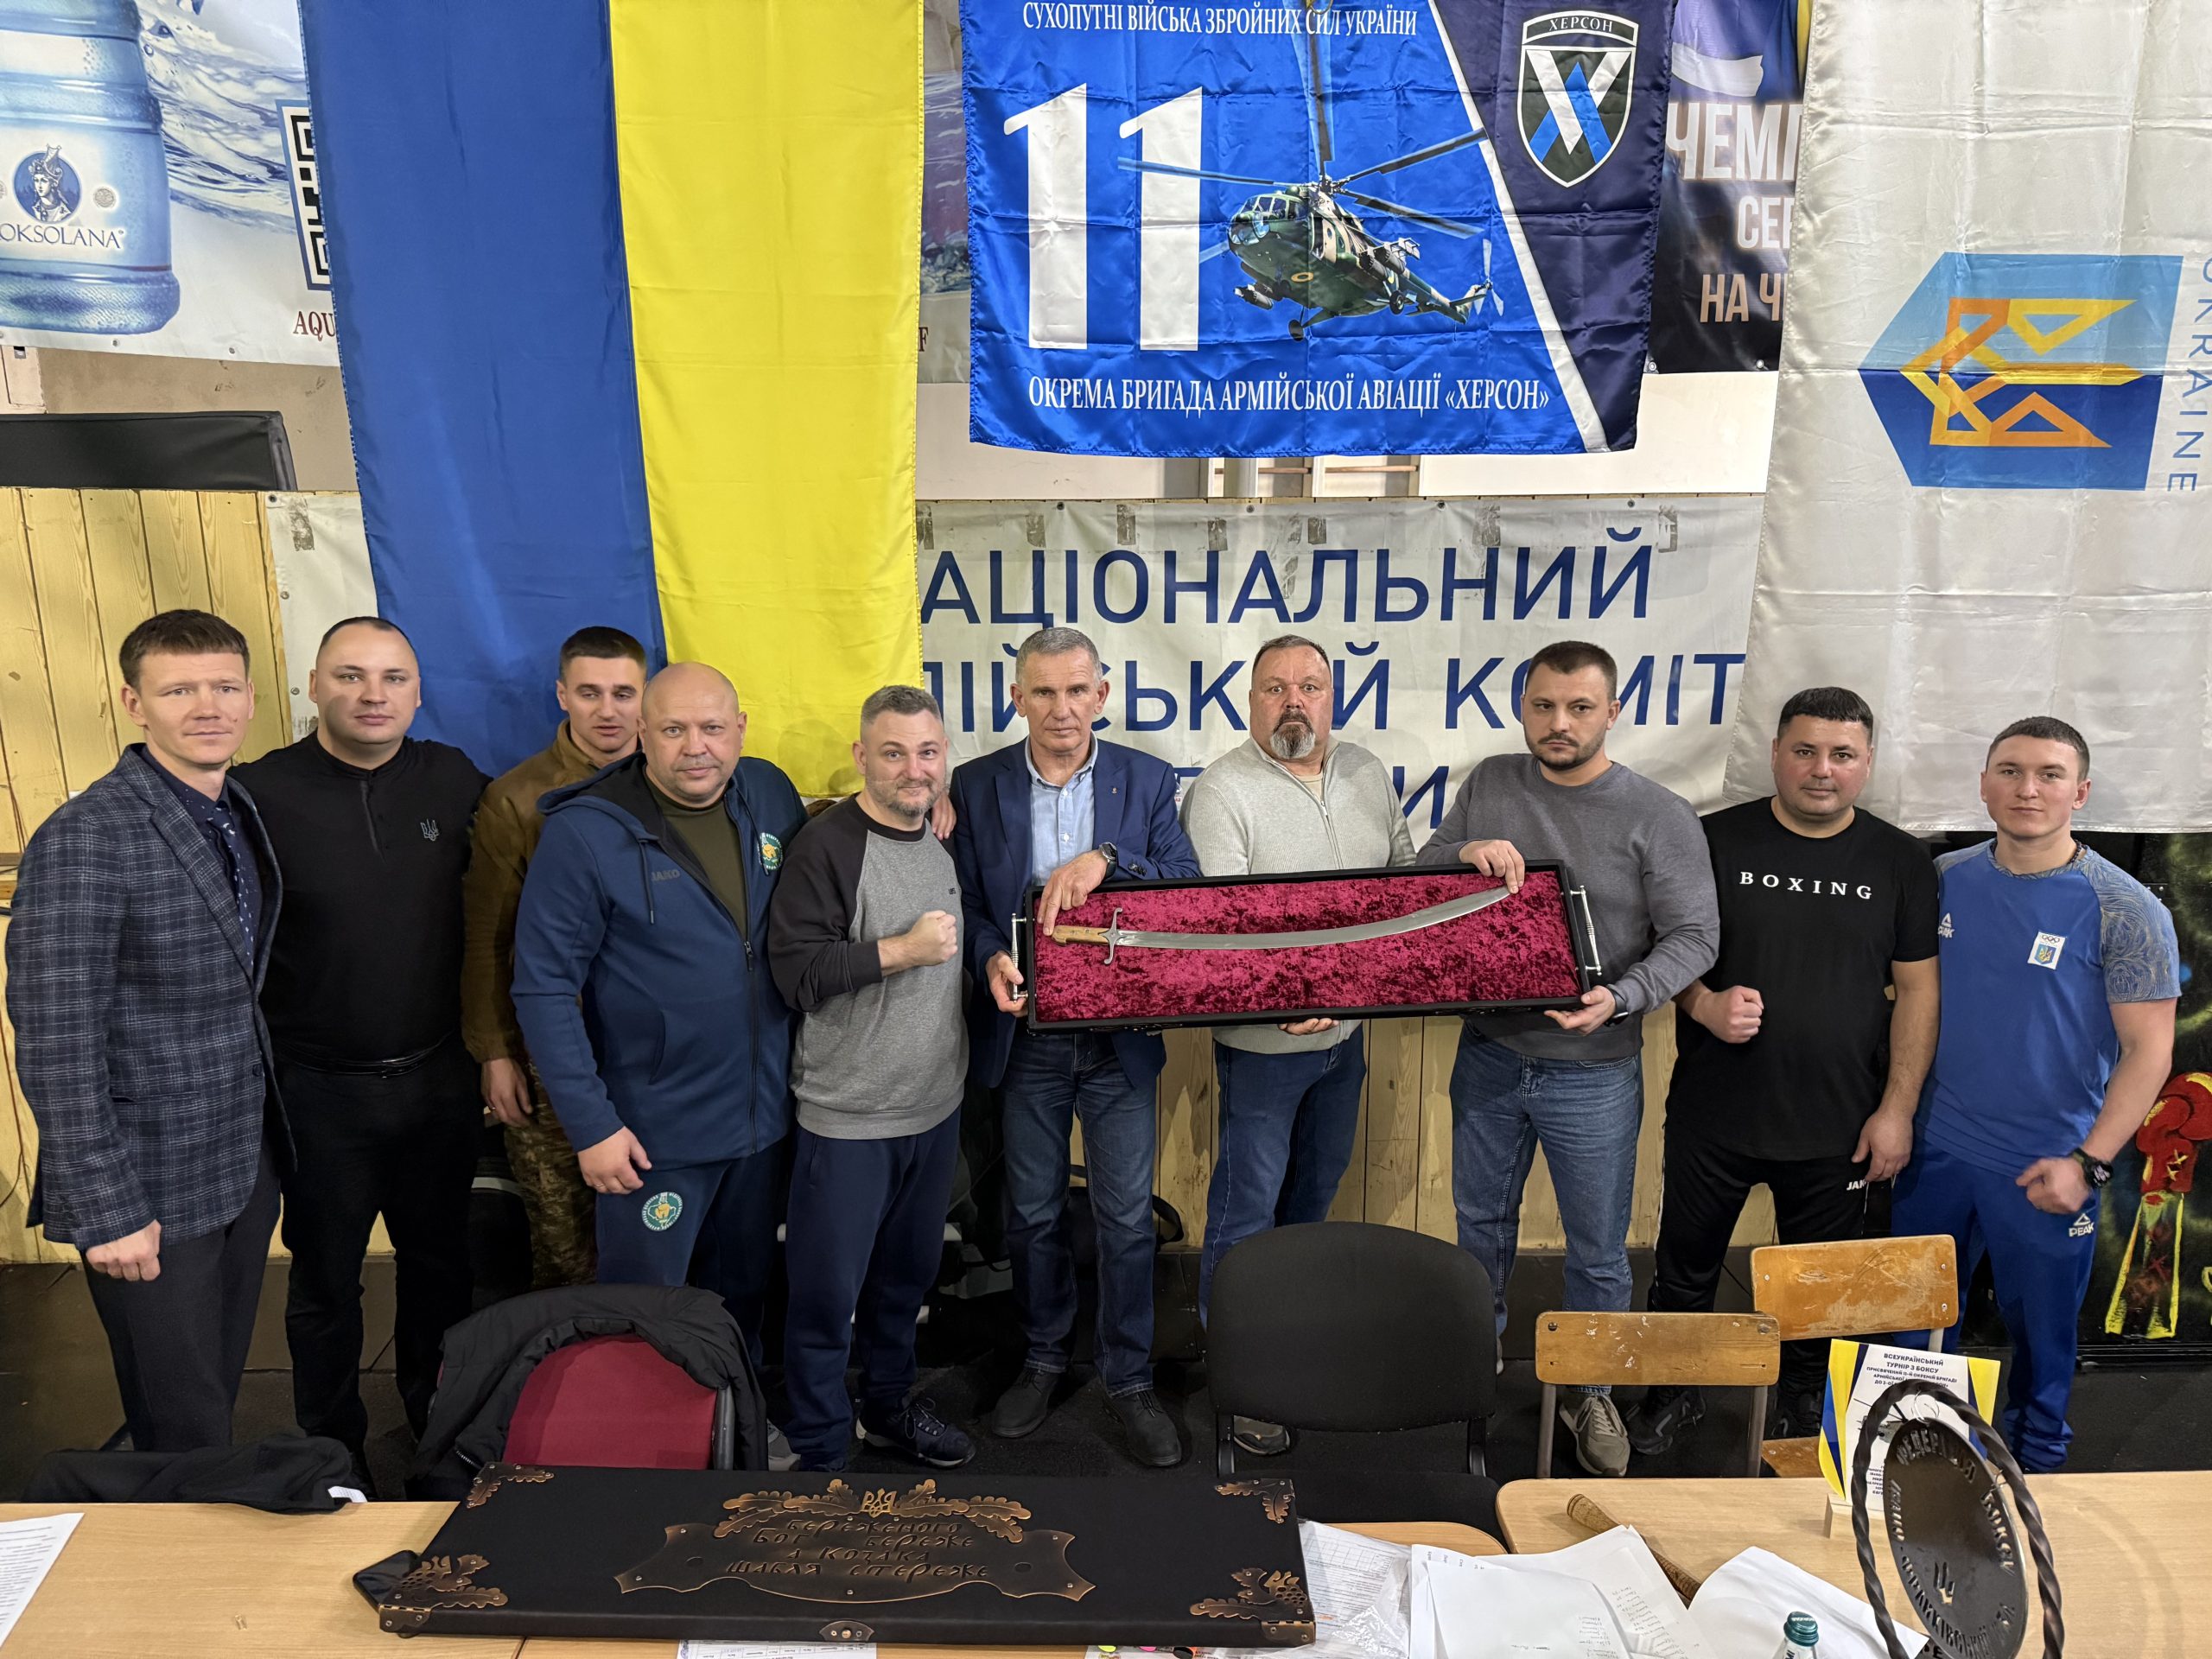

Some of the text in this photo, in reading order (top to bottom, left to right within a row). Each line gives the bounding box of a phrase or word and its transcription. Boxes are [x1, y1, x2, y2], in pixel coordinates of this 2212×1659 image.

[1023, 0, 1417, 35] СУХОПУТНІ ВІЙСЬКА ЗБРОЙНИХ СИЛ УКРАЇНИ
[1549, 16, 1613, 33] ХЕРСОН
[1004, 83, 1202, 351] 11
[0, 223, 121, 249] OKSOLANA
[1700, 273, 1750, 322] НА
[293, 311, 336, 341] AQU
[1028, 372, 1549, 419] ОКРЕМА БРИГАДА АРМІЙСЬКОЇ АВІАЦІЇ «ХЕРСОН»
[920, 526, 1653, 630] АЦІОНАЛЬНИЙ
[1739, 871, 1872, 899] BOXING
[1847, 1179, 1866, 1191] JAK
[2069, 1222, 2094, 1236] PEAK
[1884, 1353, 1944, 1366] ВСЕУКРАЇНСЬКИЙ
[1916, 1365, 1939, 1374] БОКСУ
